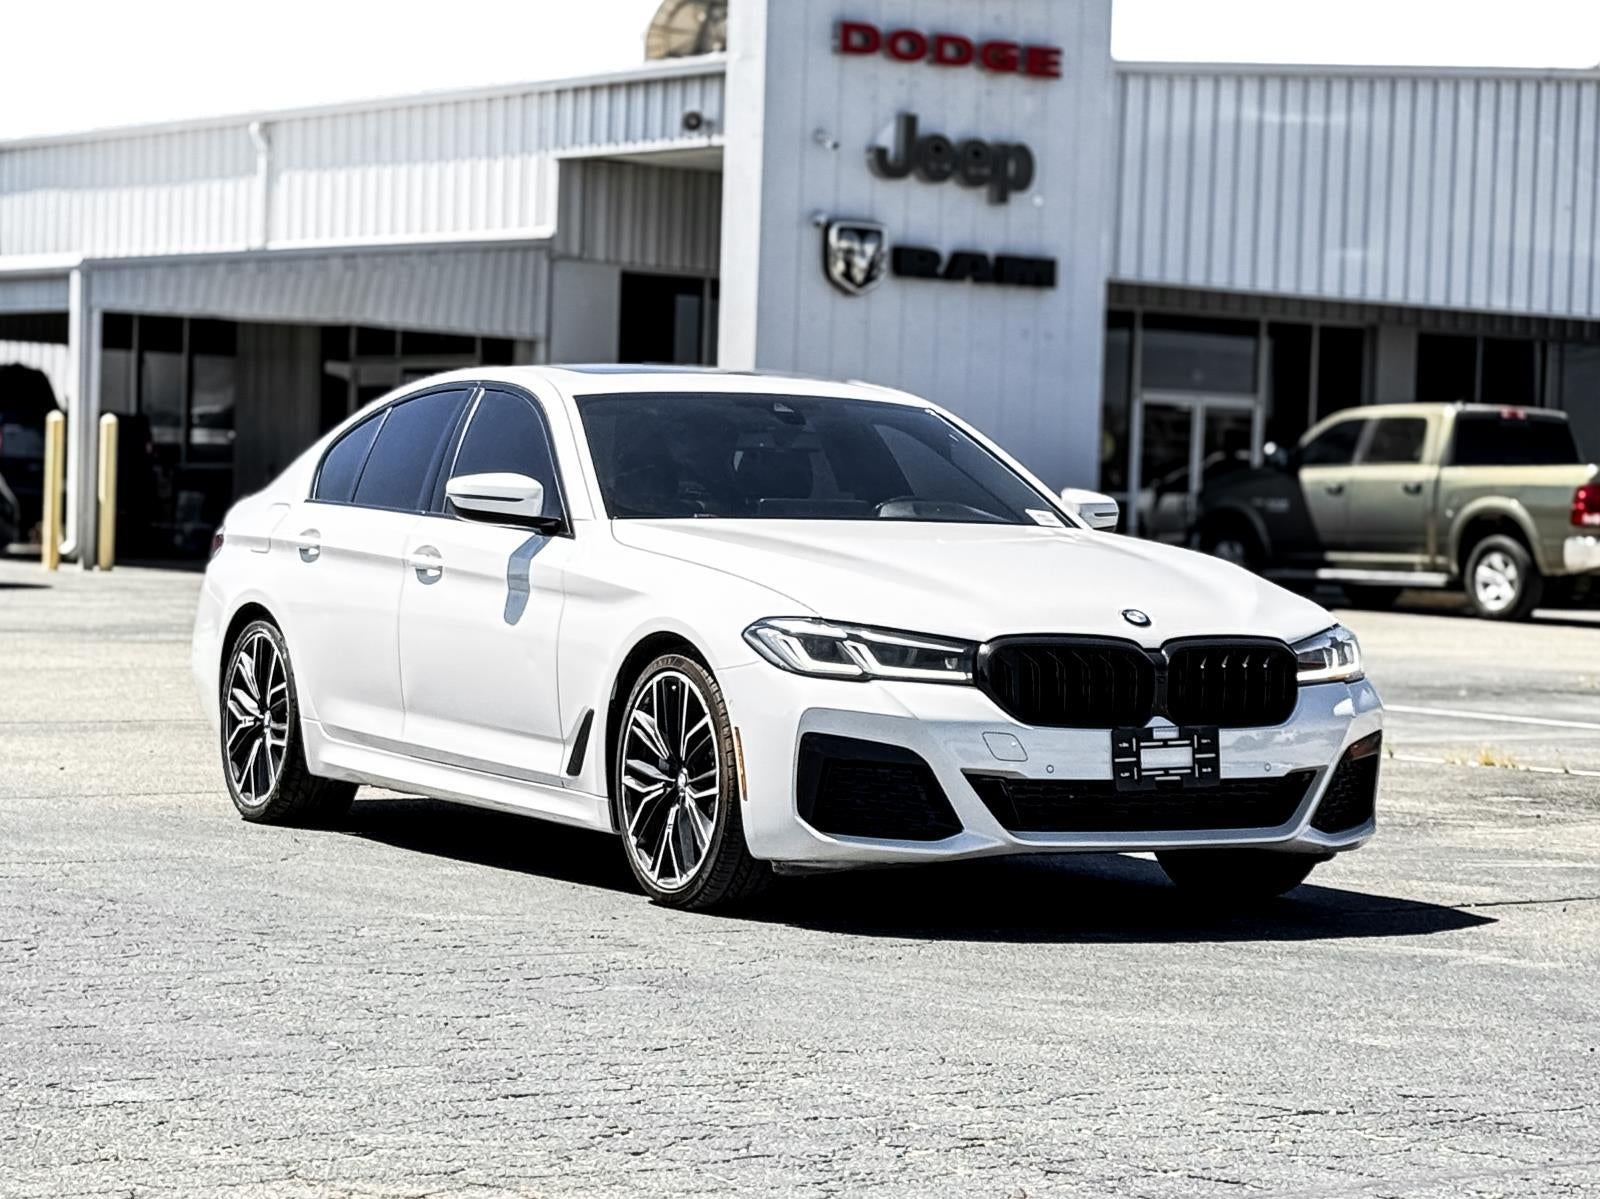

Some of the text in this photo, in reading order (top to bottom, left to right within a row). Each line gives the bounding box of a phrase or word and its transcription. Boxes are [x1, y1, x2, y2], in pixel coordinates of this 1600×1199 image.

[834, 20, 1062, 79] DODGE
[867, 112, 1035, 205] Jeep
[889, 244, 1058, 289] RAM
